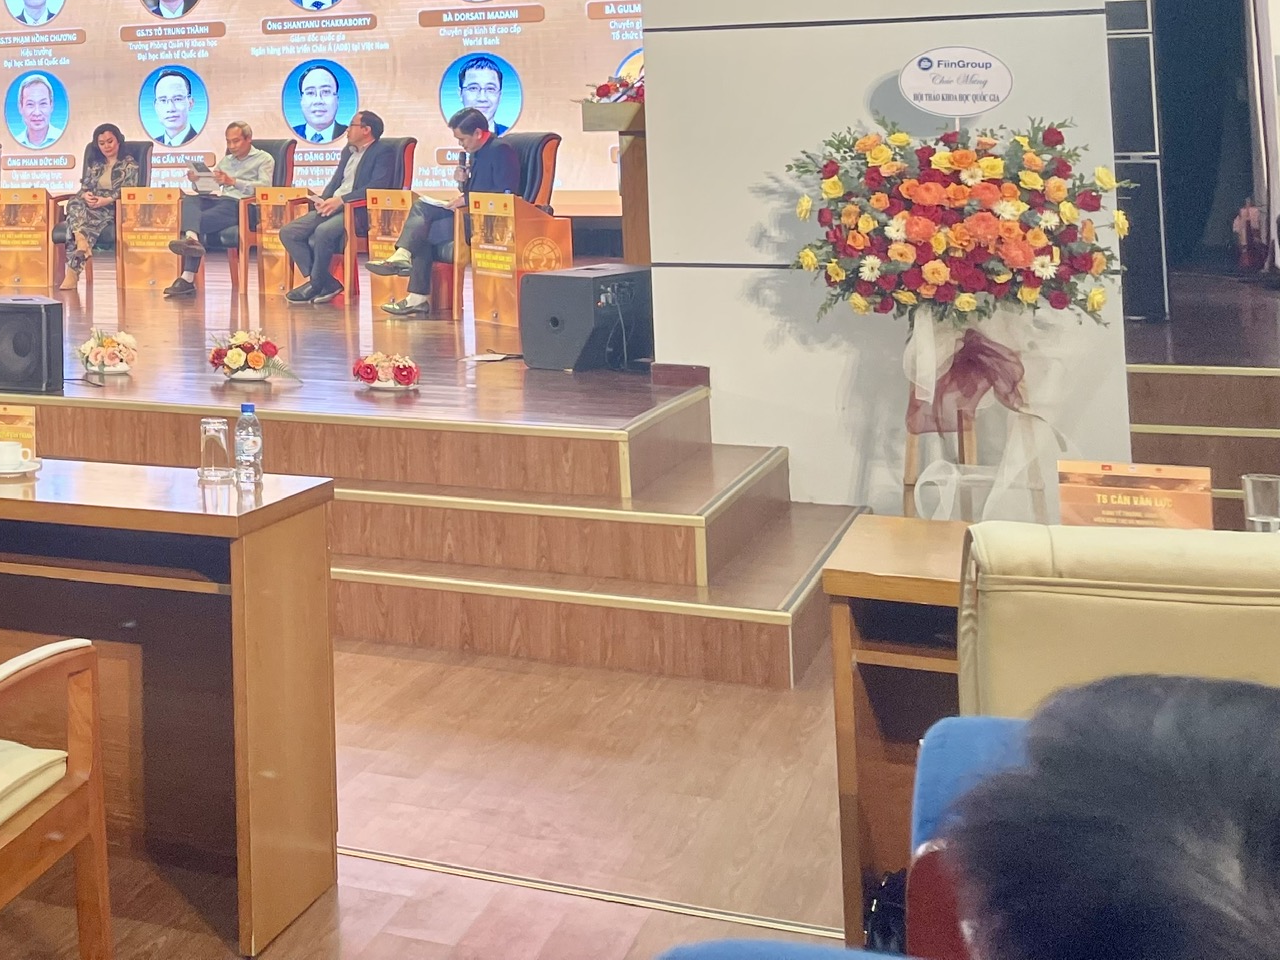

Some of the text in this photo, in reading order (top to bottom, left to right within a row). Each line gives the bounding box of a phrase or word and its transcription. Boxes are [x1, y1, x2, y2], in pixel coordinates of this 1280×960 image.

[605, 3, 641, 14] BÀ GULM
[443, 10, 518, 22] BÀ DORSATI MADANI
[266, 17, 371, 30] ÔNG SHANTANU CHAKRABORTY
[164, 27, 186, 35] TRUNG
[187, 25, 209, 34] THÀNH
[13, 36, 30, 44] PHẠM
[462, 37, 500, 46] World Bank
[937, 60, 992, 70] FiinGroup
[941, 94, 957, 102] KHOA
[989, 94, 1000, 102] GIA
[8, 158, 20, 166] ÔNG
[22, 158, 38, 166] PHAN
[152, 156, 160, 164] NG
[304, 152, 324, 162] ĐẶNG
